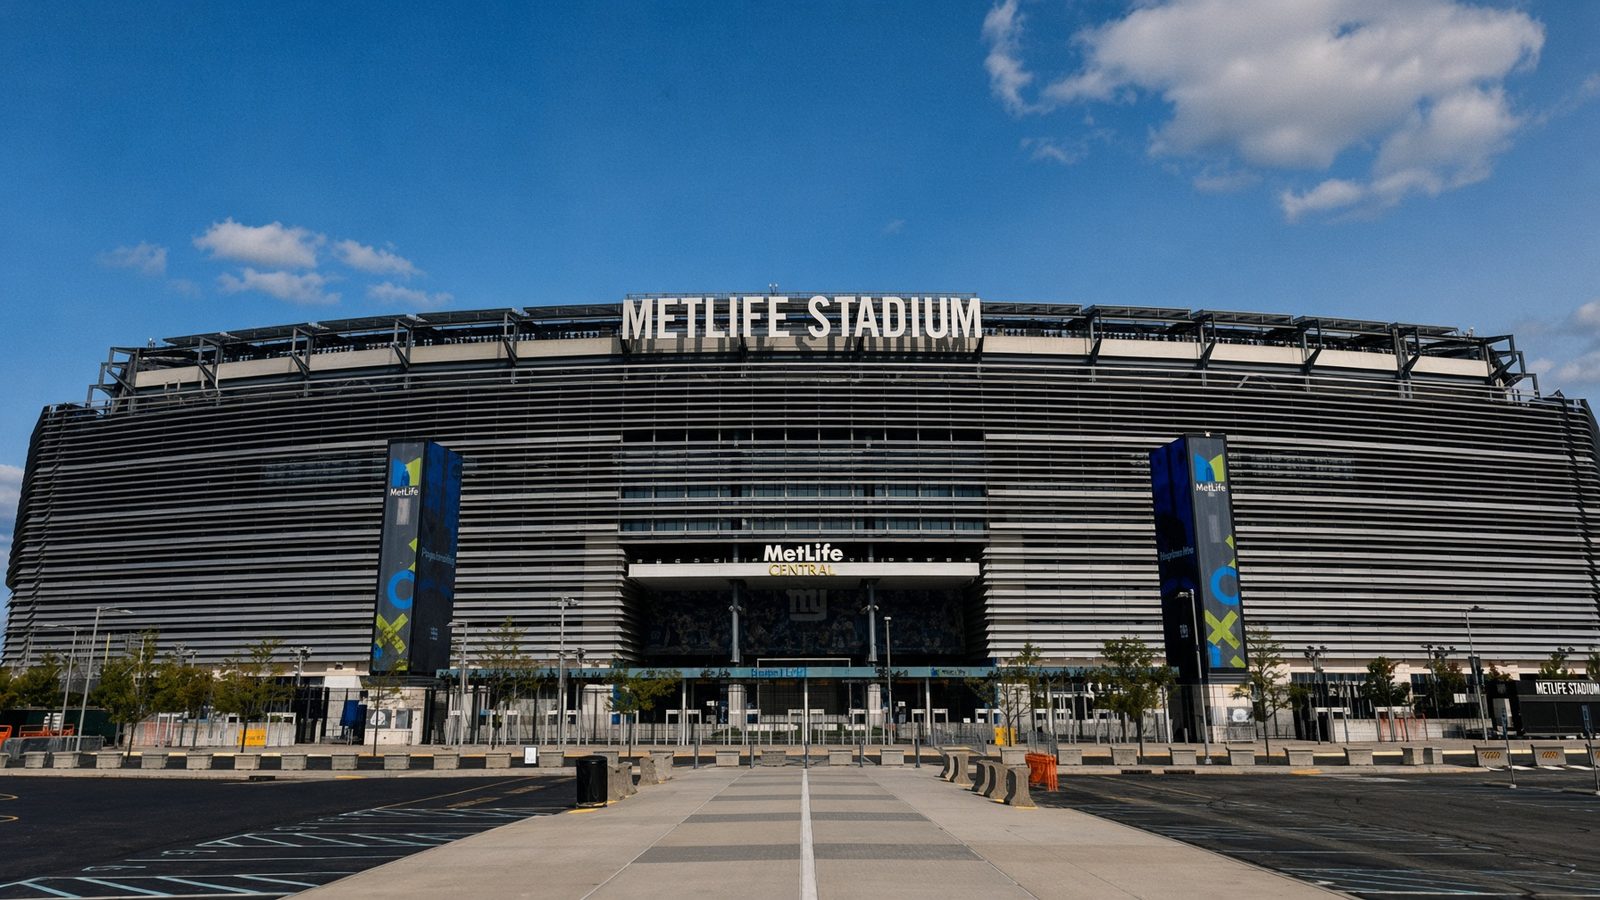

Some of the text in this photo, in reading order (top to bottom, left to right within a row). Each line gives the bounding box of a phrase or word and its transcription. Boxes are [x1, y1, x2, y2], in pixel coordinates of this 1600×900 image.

[622, 295, 982, 339] METLIFE STADIUM
[390, 486, 419, 497] MetLife
[1196, 482, 1226, 492] MetLife
[763, 543, 844, 562] MetLife
[768, 563, 838, 577] CENTRAL
[1535, 682, 1600, 695] METLIFE STADIUM
